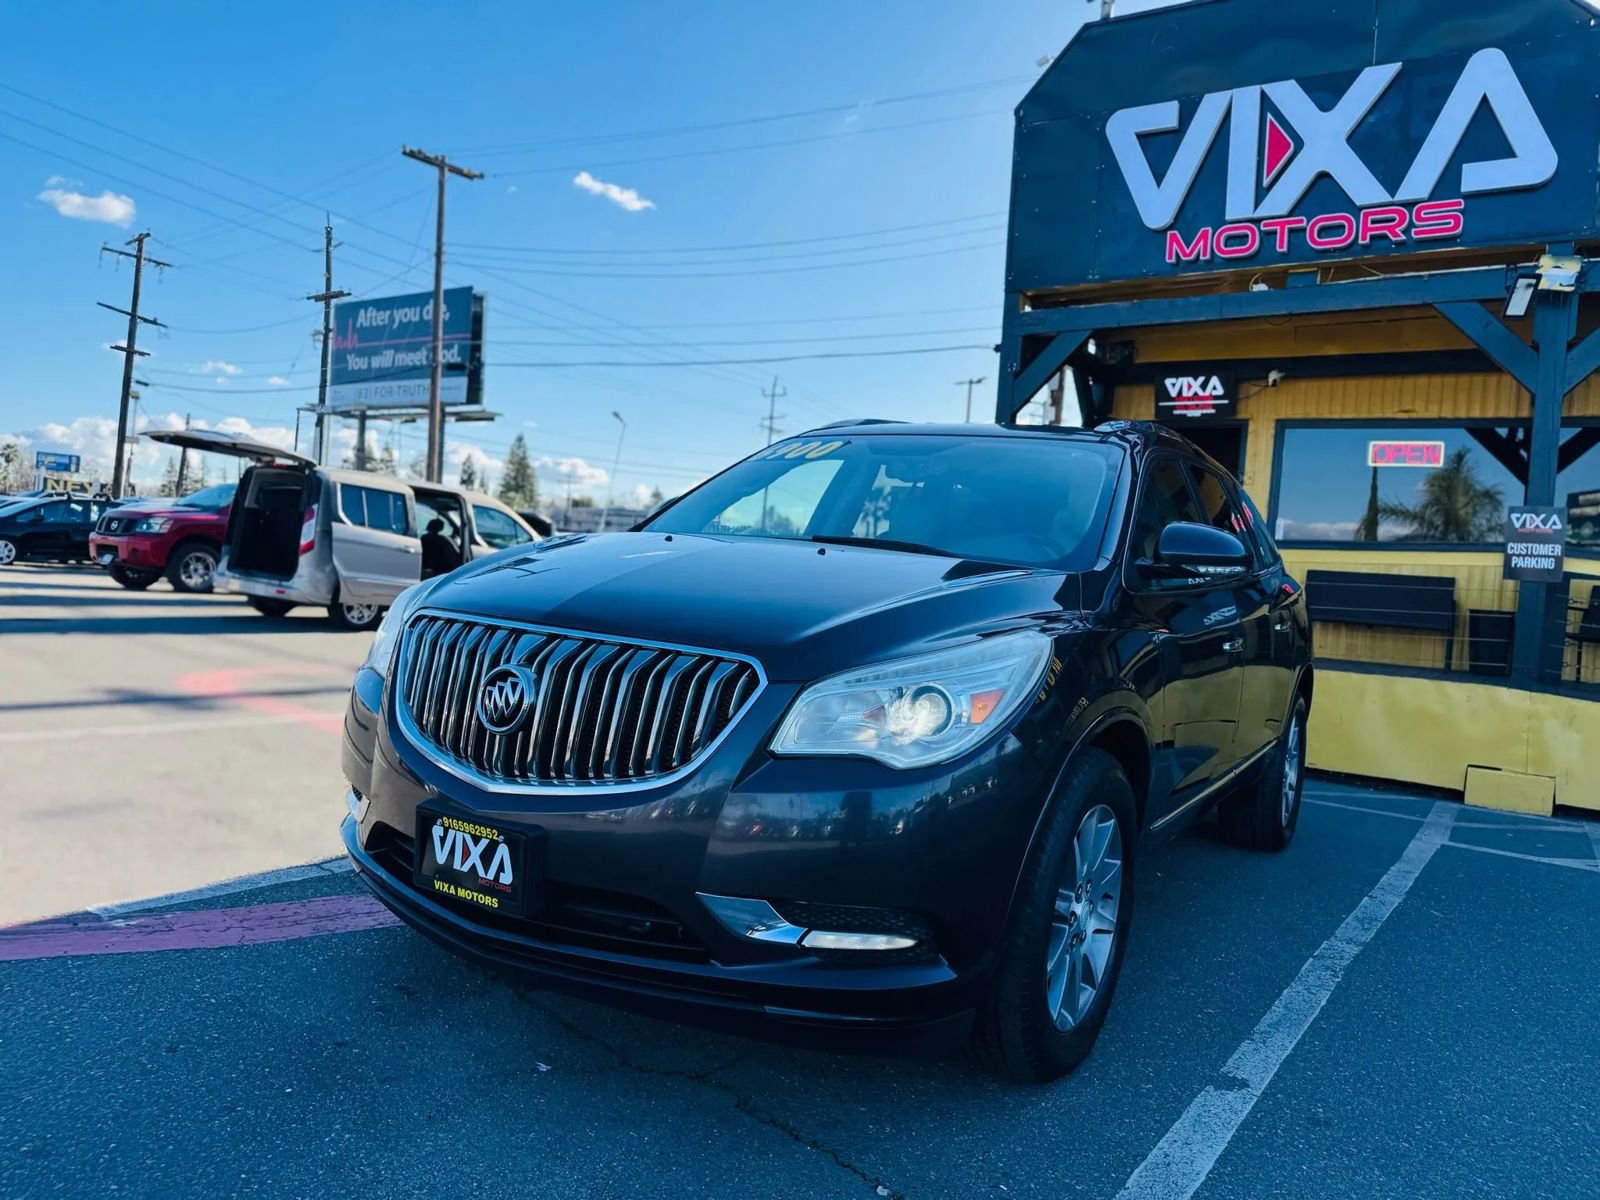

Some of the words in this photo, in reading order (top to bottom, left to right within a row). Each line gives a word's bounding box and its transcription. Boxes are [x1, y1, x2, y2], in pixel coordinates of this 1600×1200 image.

[1105, 47, 1559, 231] VIXA
[1165, 199, 1465, 264] MOTORS
[356, 306, 391, 328] After
[392, 303, 421, 329] you
[423, 299, 450, 322] de,
[346, 354, 368, 371] You
[370, 350, 394, 369] will
[395, 348, 427, 366] meet
[431, 344, 461, 365] od.
[1164, 375, 1224, 398] VIXA
[1373, 443, 1441, 464] OPEN
[1510, 513, 1562, 530] VIXA
[1507, 542, 1562, 556] CUSTOMER
[1511, 556, 1555, 569] PARKING
[442, 816, 498, 840] 9165962952
[432, 825, 513, 885] VIXA
[434, 879, 456, 895] VIXA
[457, 887, 499, 908] MOTORS
